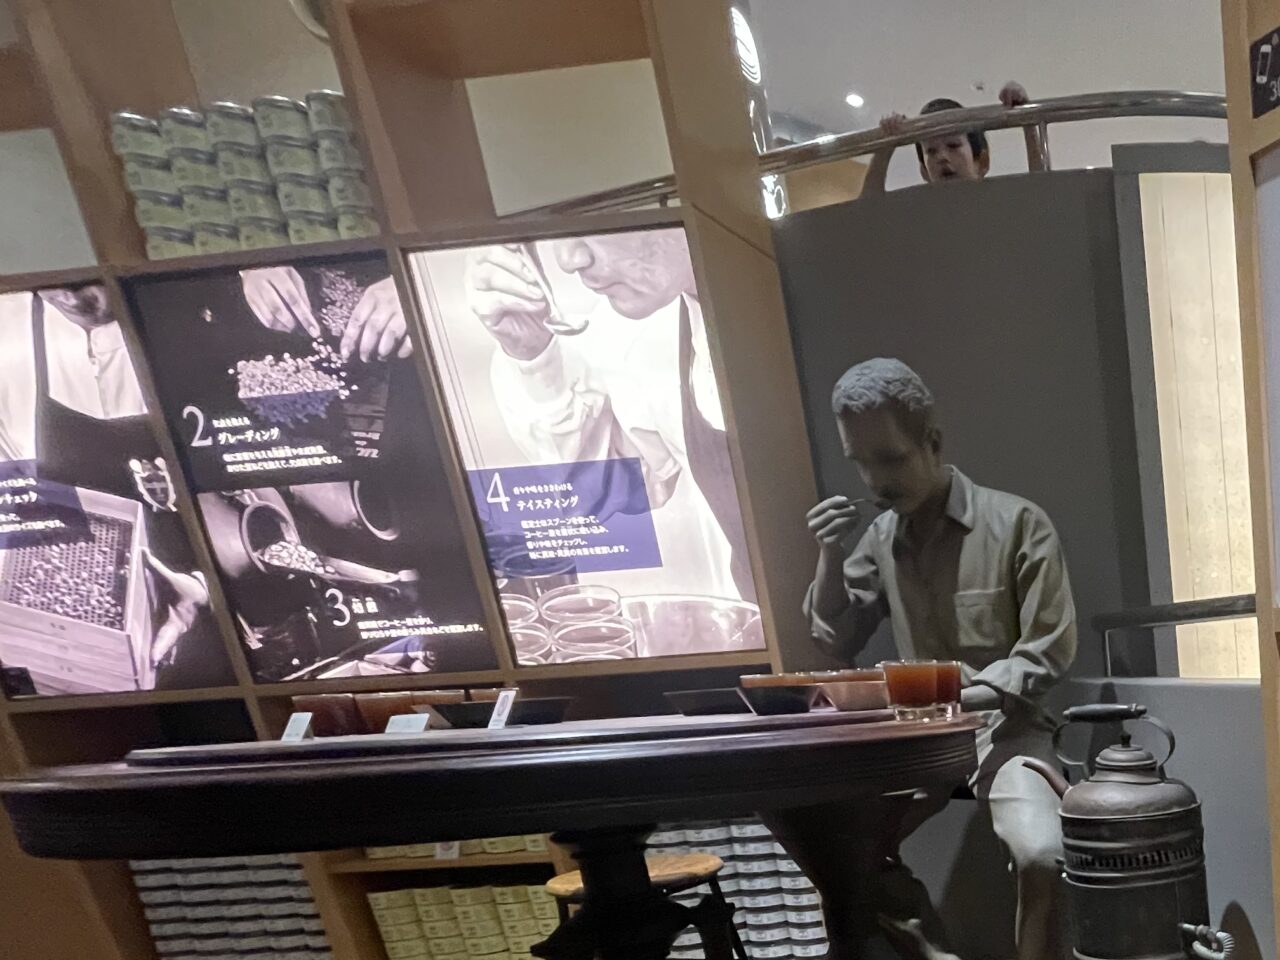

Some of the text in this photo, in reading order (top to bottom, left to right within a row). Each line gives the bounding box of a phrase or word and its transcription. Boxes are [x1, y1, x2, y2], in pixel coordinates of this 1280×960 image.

[182, 405, 213, 448] 2
[218, 426, 281, 445] グレーディング
[486, 472, 511, 513] 4
[516, 494, 580, 512] テイスティング
[325, 588, 351, 627] 3
